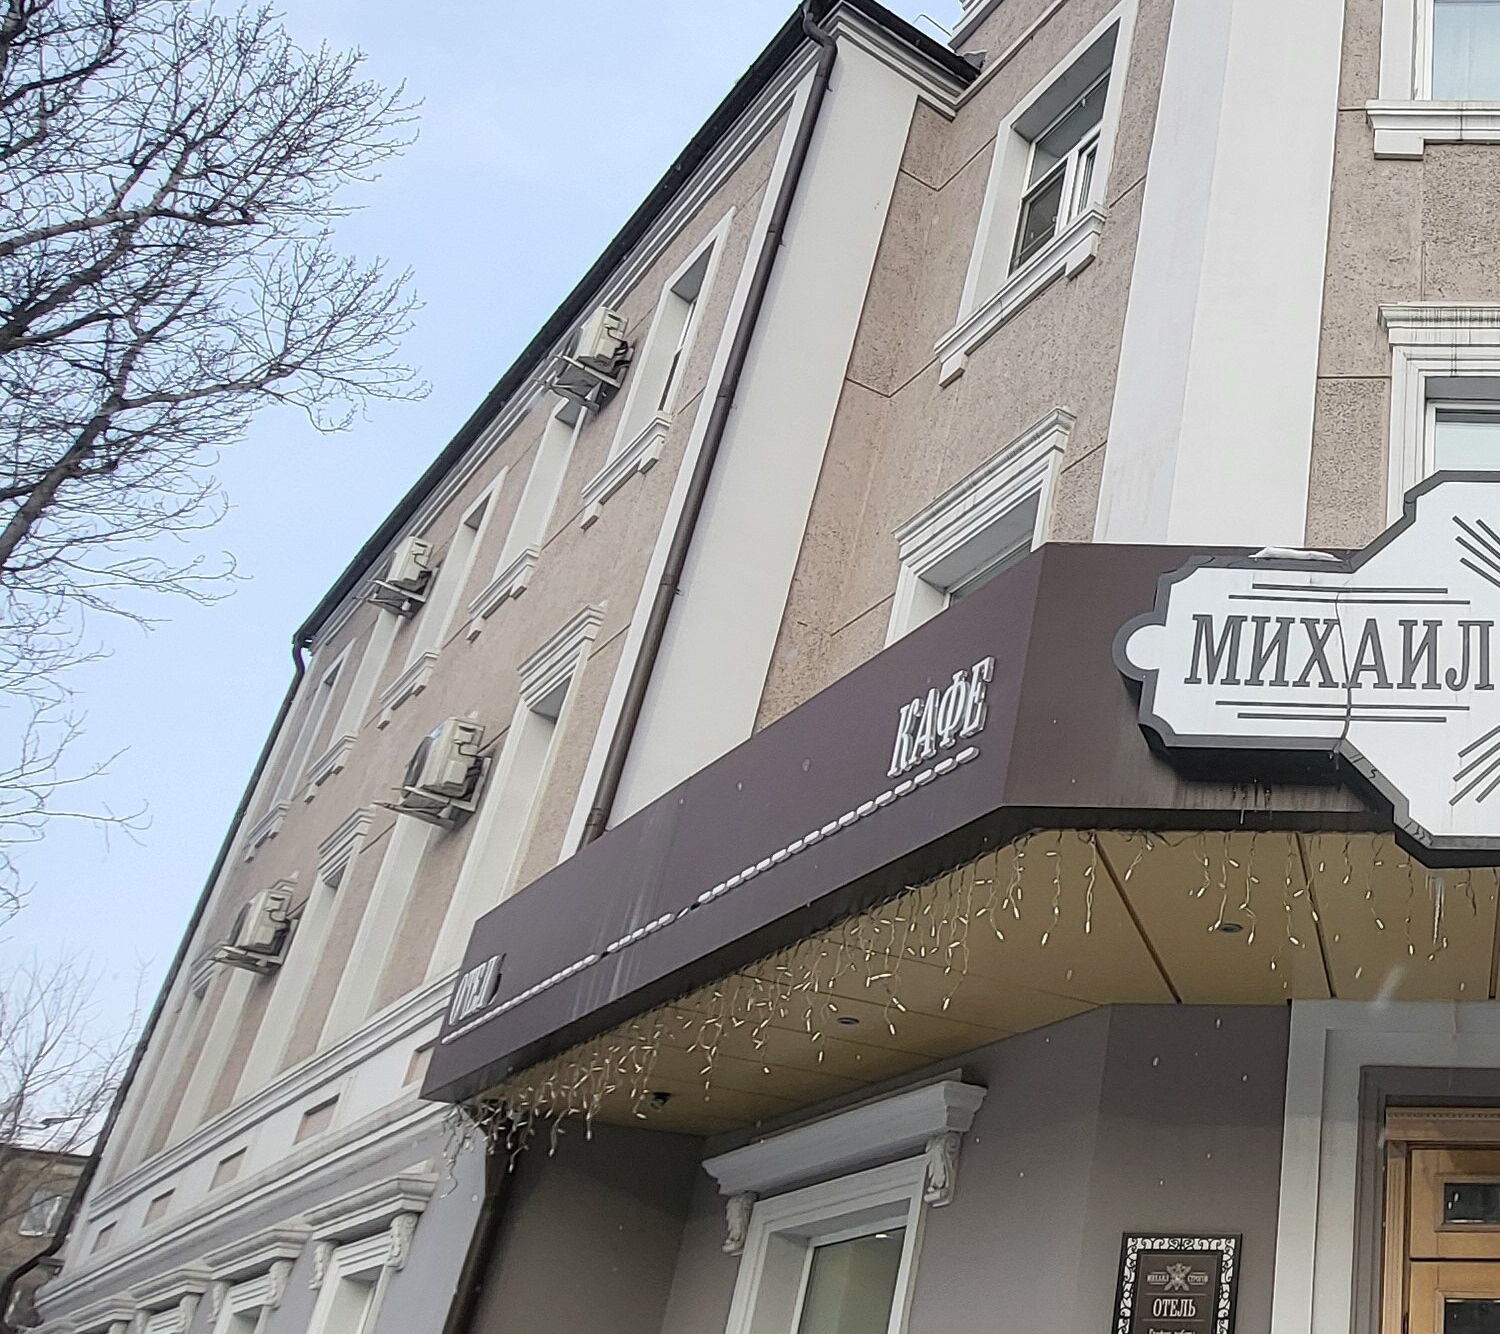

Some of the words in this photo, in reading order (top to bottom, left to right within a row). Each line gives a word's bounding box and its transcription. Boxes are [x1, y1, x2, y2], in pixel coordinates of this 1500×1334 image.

[1184, 614, 1494, 691] МИХАИЛ
[887, 656, 995, 777] КАФЕ
[1153, 1298, 1196, 1317] ОТЕЛЬ
